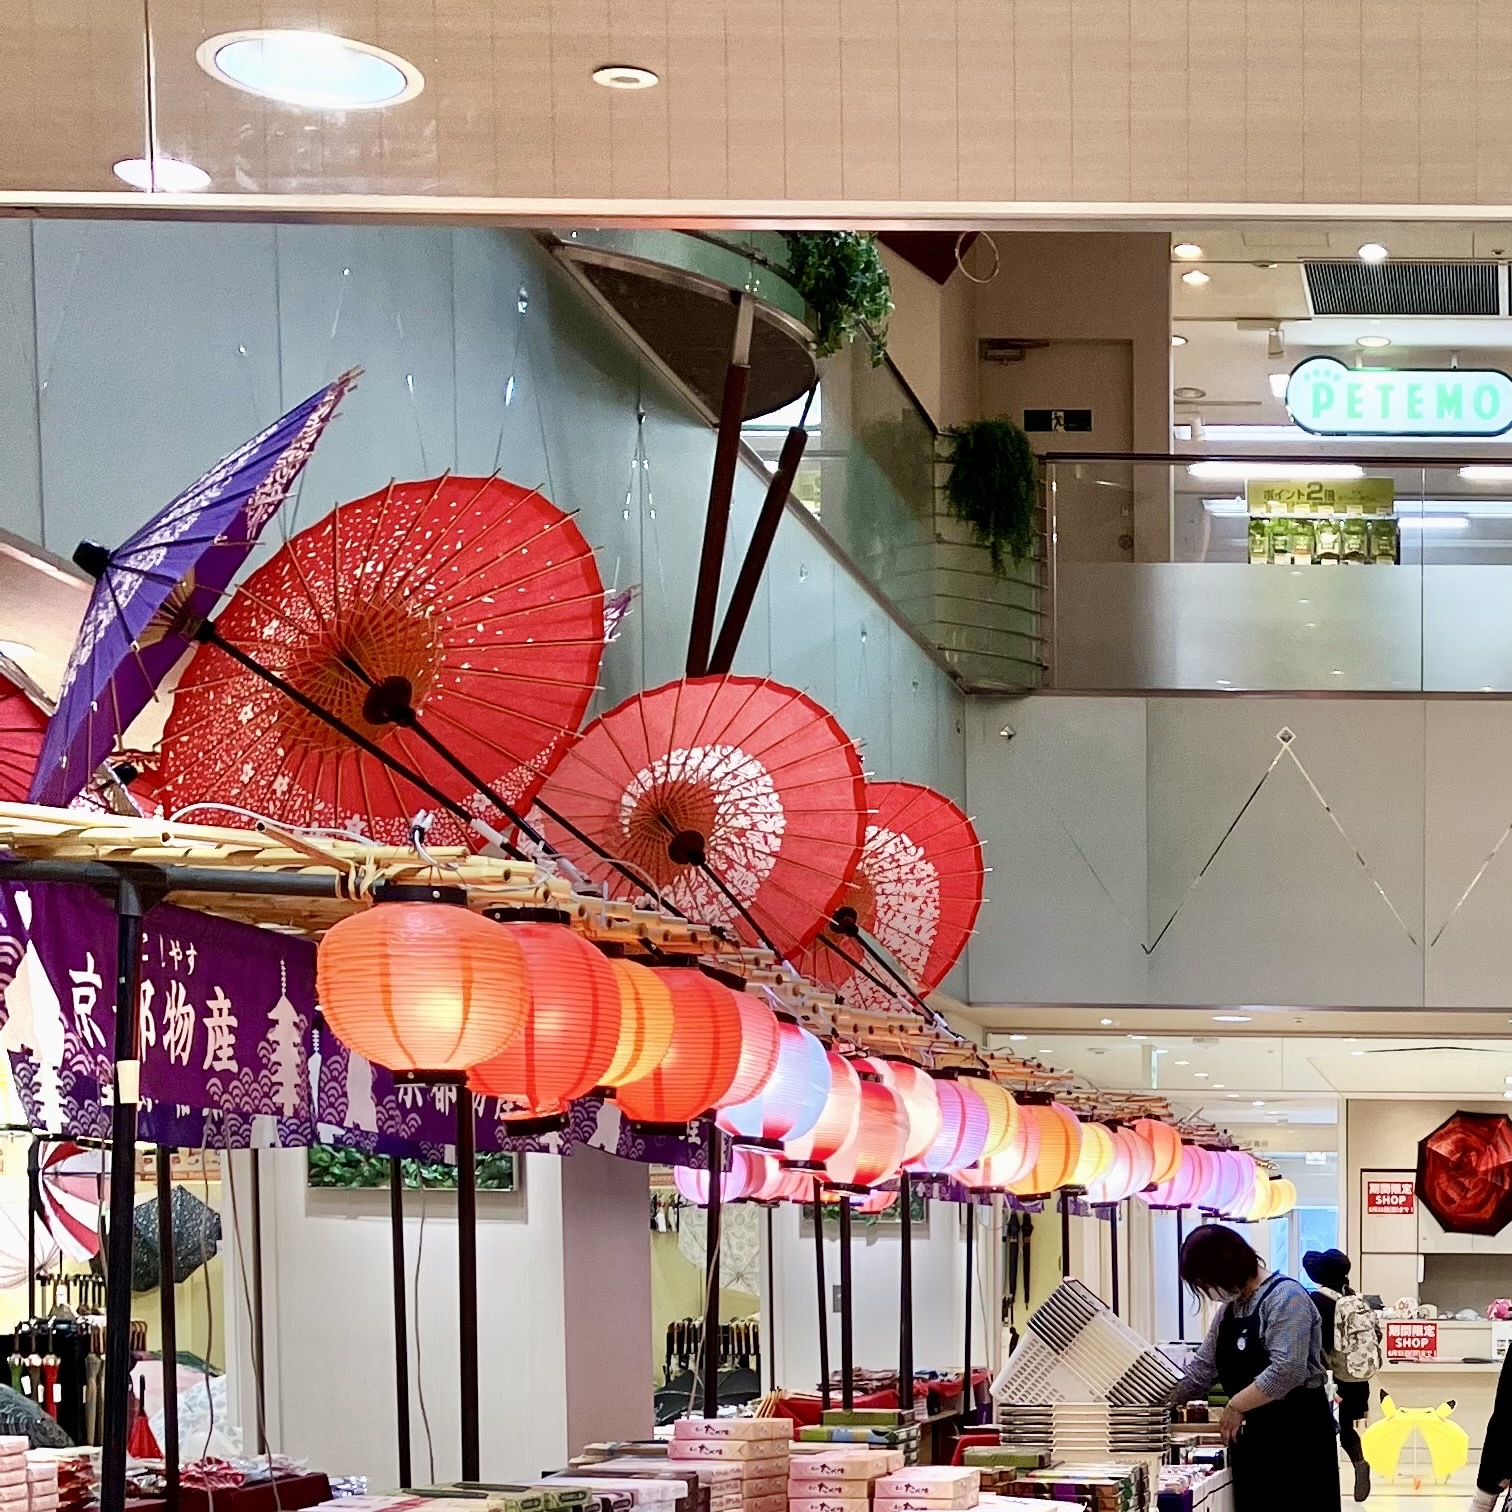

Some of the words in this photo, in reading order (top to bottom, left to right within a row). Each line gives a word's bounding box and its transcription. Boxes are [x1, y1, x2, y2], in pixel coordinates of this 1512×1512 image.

[1312, 382, 1501, 420] PETEMO
[1375, 1195, 1407, 1205] SHOP
[1395, 1338, 1429, 1348] SHOP
